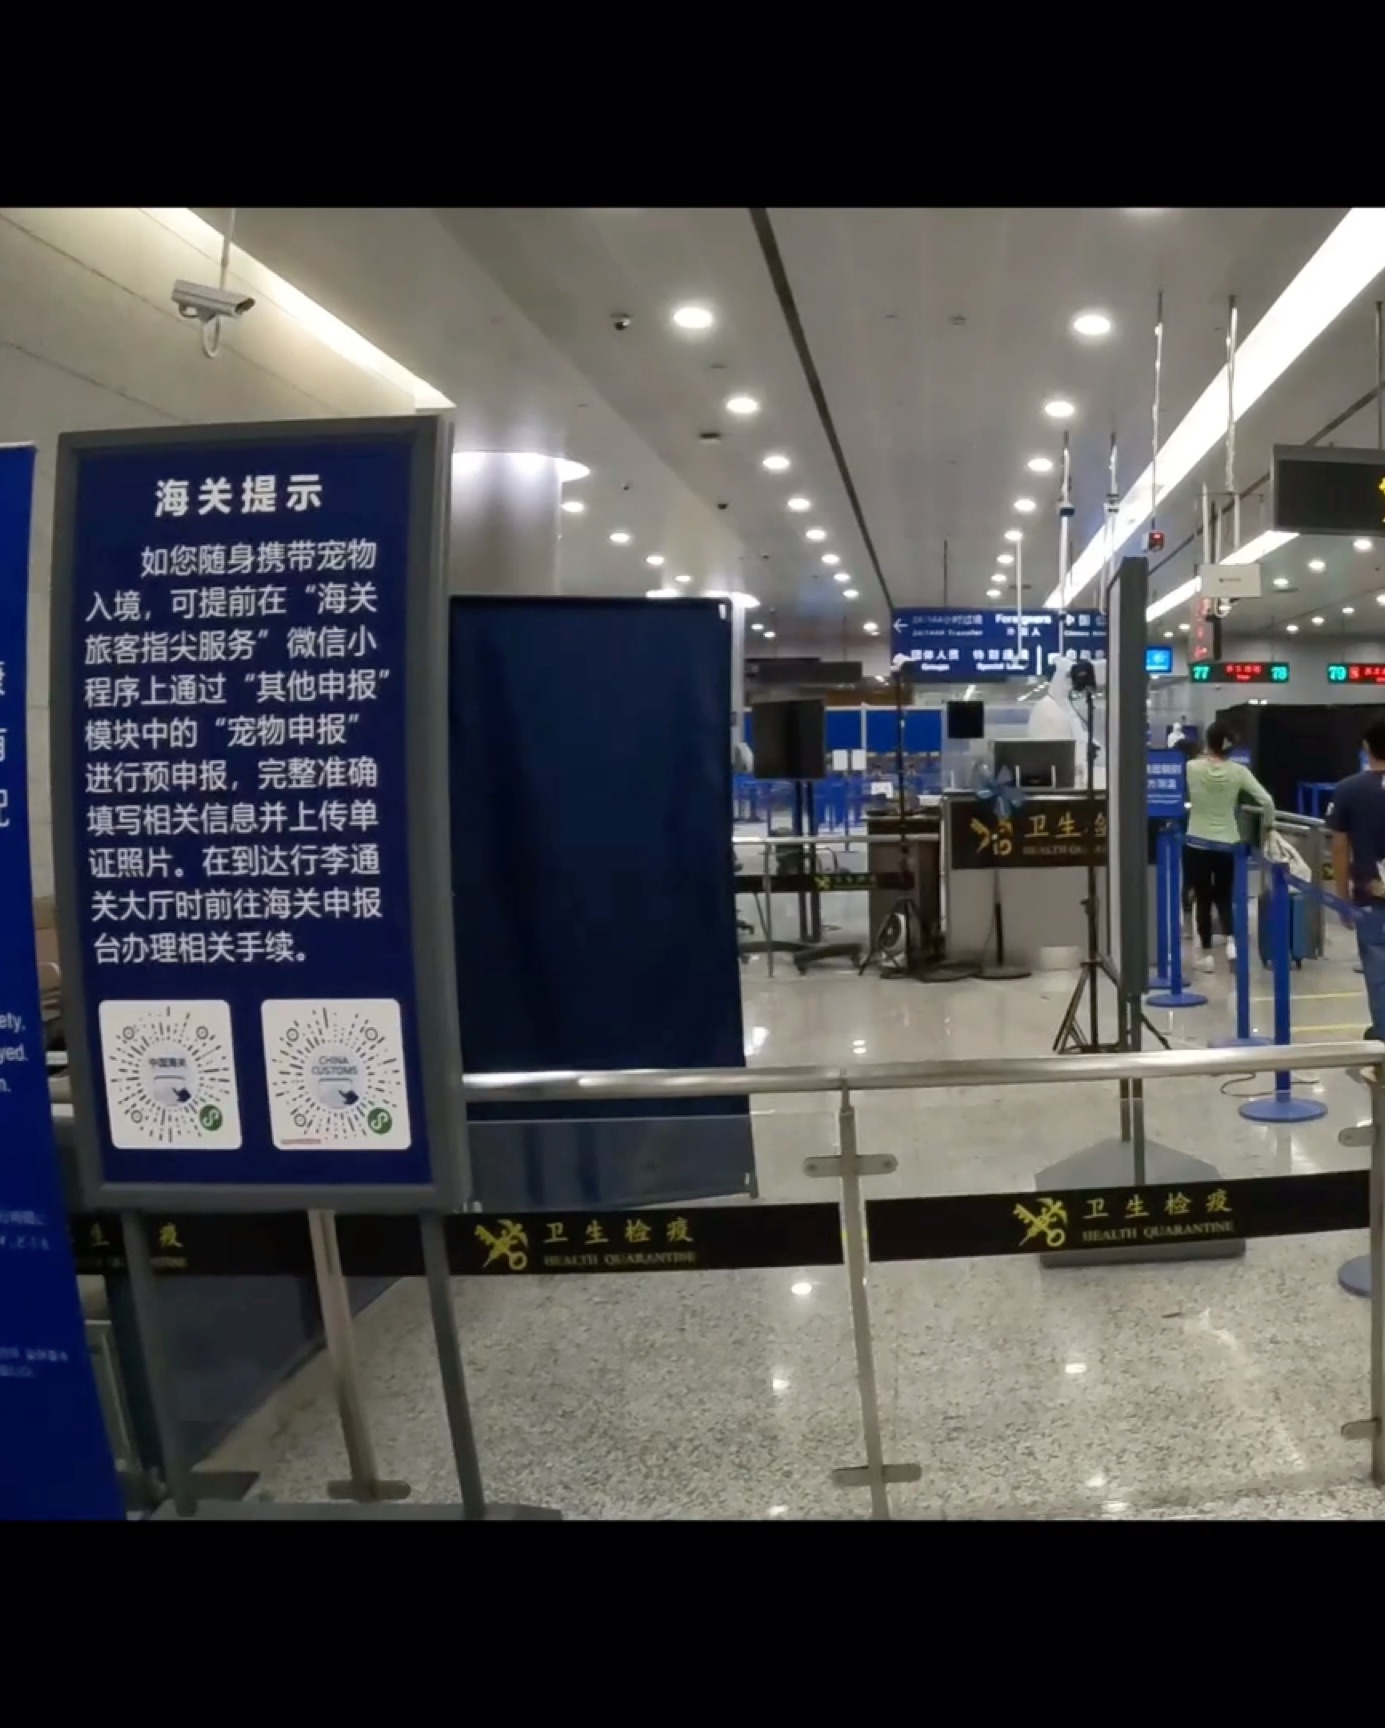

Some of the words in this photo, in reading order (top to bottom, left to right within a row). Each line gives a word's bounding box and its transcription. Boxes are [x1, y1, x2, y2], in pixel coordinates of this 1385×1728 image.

[155, 474, 323, 517] 海关提示
[141, 539, 377, 577] 如您随身携带宠物
[1192, 666, 1210, 680] 77
[1328, 666, 1347, 681] 79
[87, 800, 379, 837] 填写相关信息并上传单
[88, 843, 381, 879] 证照片。在到达行李通
[91, 886, 383, 922] 关大厅时前往海关申报
[94, 932, 307, 964] 台办理相关手续。
[311, 1065, 359, 1076] CUSTOMS
[318, 1055, 349, 1066] CHINA
[1083, 1189, 1232, 1220] 卫生检疫
[544, 1217, 694, 1245] 卫生检疫
[1083, 1227, 1137, 1243] HEALTH
[1144, 1219, 1236, 1240] QUARANTINE
[544, 1252, 598, 1267] HEALTH
[604, 1250, 696, 1266] QUARANTINE
